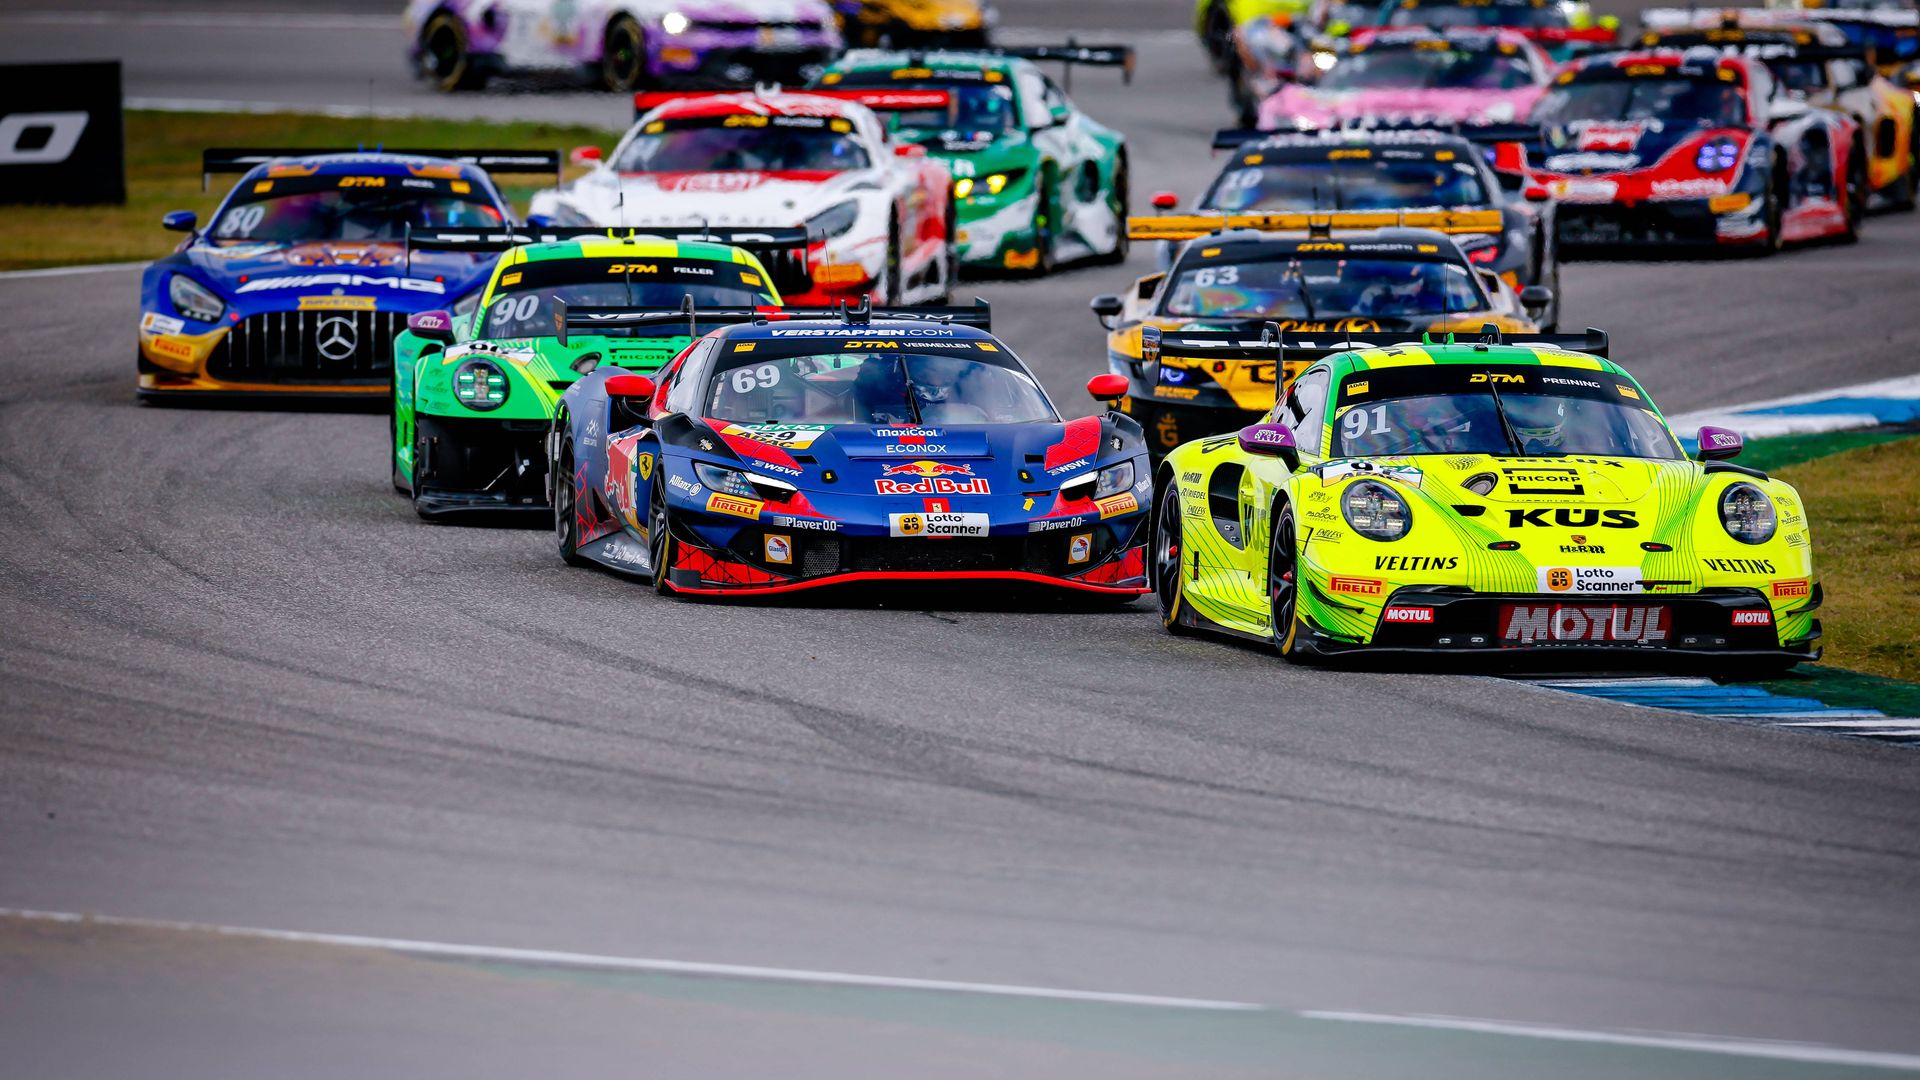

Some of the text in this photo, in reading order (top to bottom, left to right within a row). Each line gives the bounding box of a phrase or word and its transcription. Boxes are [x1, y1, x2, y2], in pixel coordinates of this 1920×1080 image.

[338, 176, 385, 188] DTM
[219, 206, 264, 237] 80
[1296, 242, 1345, 251] DTM
[607, 264, 658, 273] DTM
[673, 266, 713, 275] FELLER
[1195, 266, 1238, 286] 63
[322, 273, 445, 294] AMG
[492, 295, 539, 326] 90
[772, 329, 953, 337] VERSTAPPEN.COM
[844, 341, 898, 349] DTM
[731, 363, 780, 394] 69
[1470, 373, 1526, 384] DTM
[1542, 377, 1601, 388] PREINING
[1343, 404, 1391, 440] 91
[1256, 430, 1286, 443] KW
[886, 444, 947, 454] ECONOX
[764, 461, 804, 476] WSVK
[1056, 459, 1090, 473] WSVK
[669, 474, 691, 491] Allianz
[874, 478, 991, 495] Red Bull
[711, 496, 758, 516] PIRELLI
[1103, 496, 1135, 515] PIRELLI
[926, 513, 963, 522] Lotto
[1306, 510, 1339, 521] PADDOCK
[927, 523, 982, 536] Scanner
[1374, 556, 1459, 571] VELTINS
[1702, 558, 1776, 575] VELTINS
[1576, 568, 1614, 578] Lotto
[1331, 577, 1382, 594] PIRELLI
[1577, 579, 1634, 592] Scanner
[1772, 580, 1809, 597] PIRELLI
[1386, 608, 1431, 620] MOTUL
[1734, 611, 1769, 624] MOTUL
[1505, 606, 1667, 641] MOTUL
